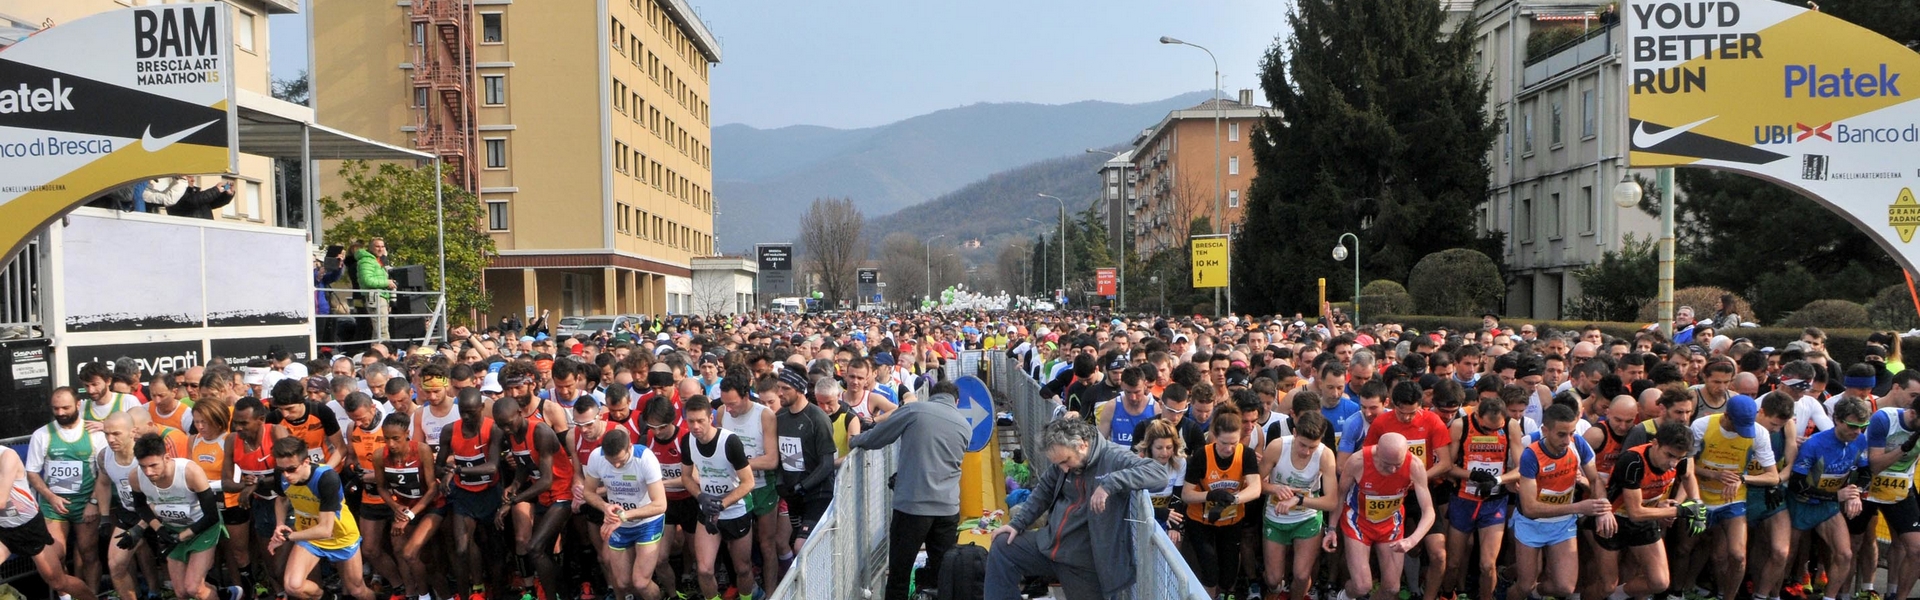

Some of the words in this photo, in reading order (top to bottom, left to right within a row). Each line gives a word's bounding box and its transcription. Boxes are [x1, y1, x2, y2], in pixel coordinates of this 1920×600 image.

[1632, 2, 1740, 29] YOU'D
[134, 7, 218, 58] BAM
[1634, 33, 1763, 62] BETTER
[137, 59, 192, 72] BRESCIA
[194, 58, 218, 70] ART
[1633, 66, 1706, 94] RUN
[1784, 63, 1900, 98] Platek
[1754, 124, 1792, 145] UBI
[1837, 124, 1899, 144] Banco
[1903, 124, 1919, 142] di
[29, 138, 45, 157] di
[48, 137, 112, 156] Brescia
[780, 442, 798, 454] 4171
[51, 467, 80, 477] 2503
[397, 474, 406, 484] 2
[704, 484, 730, 495] 4162
[1873, 477, 1906, 490] 3444
[1369, 500, 1401, 510] 3678
[160, 509, 188, 519] 4258
